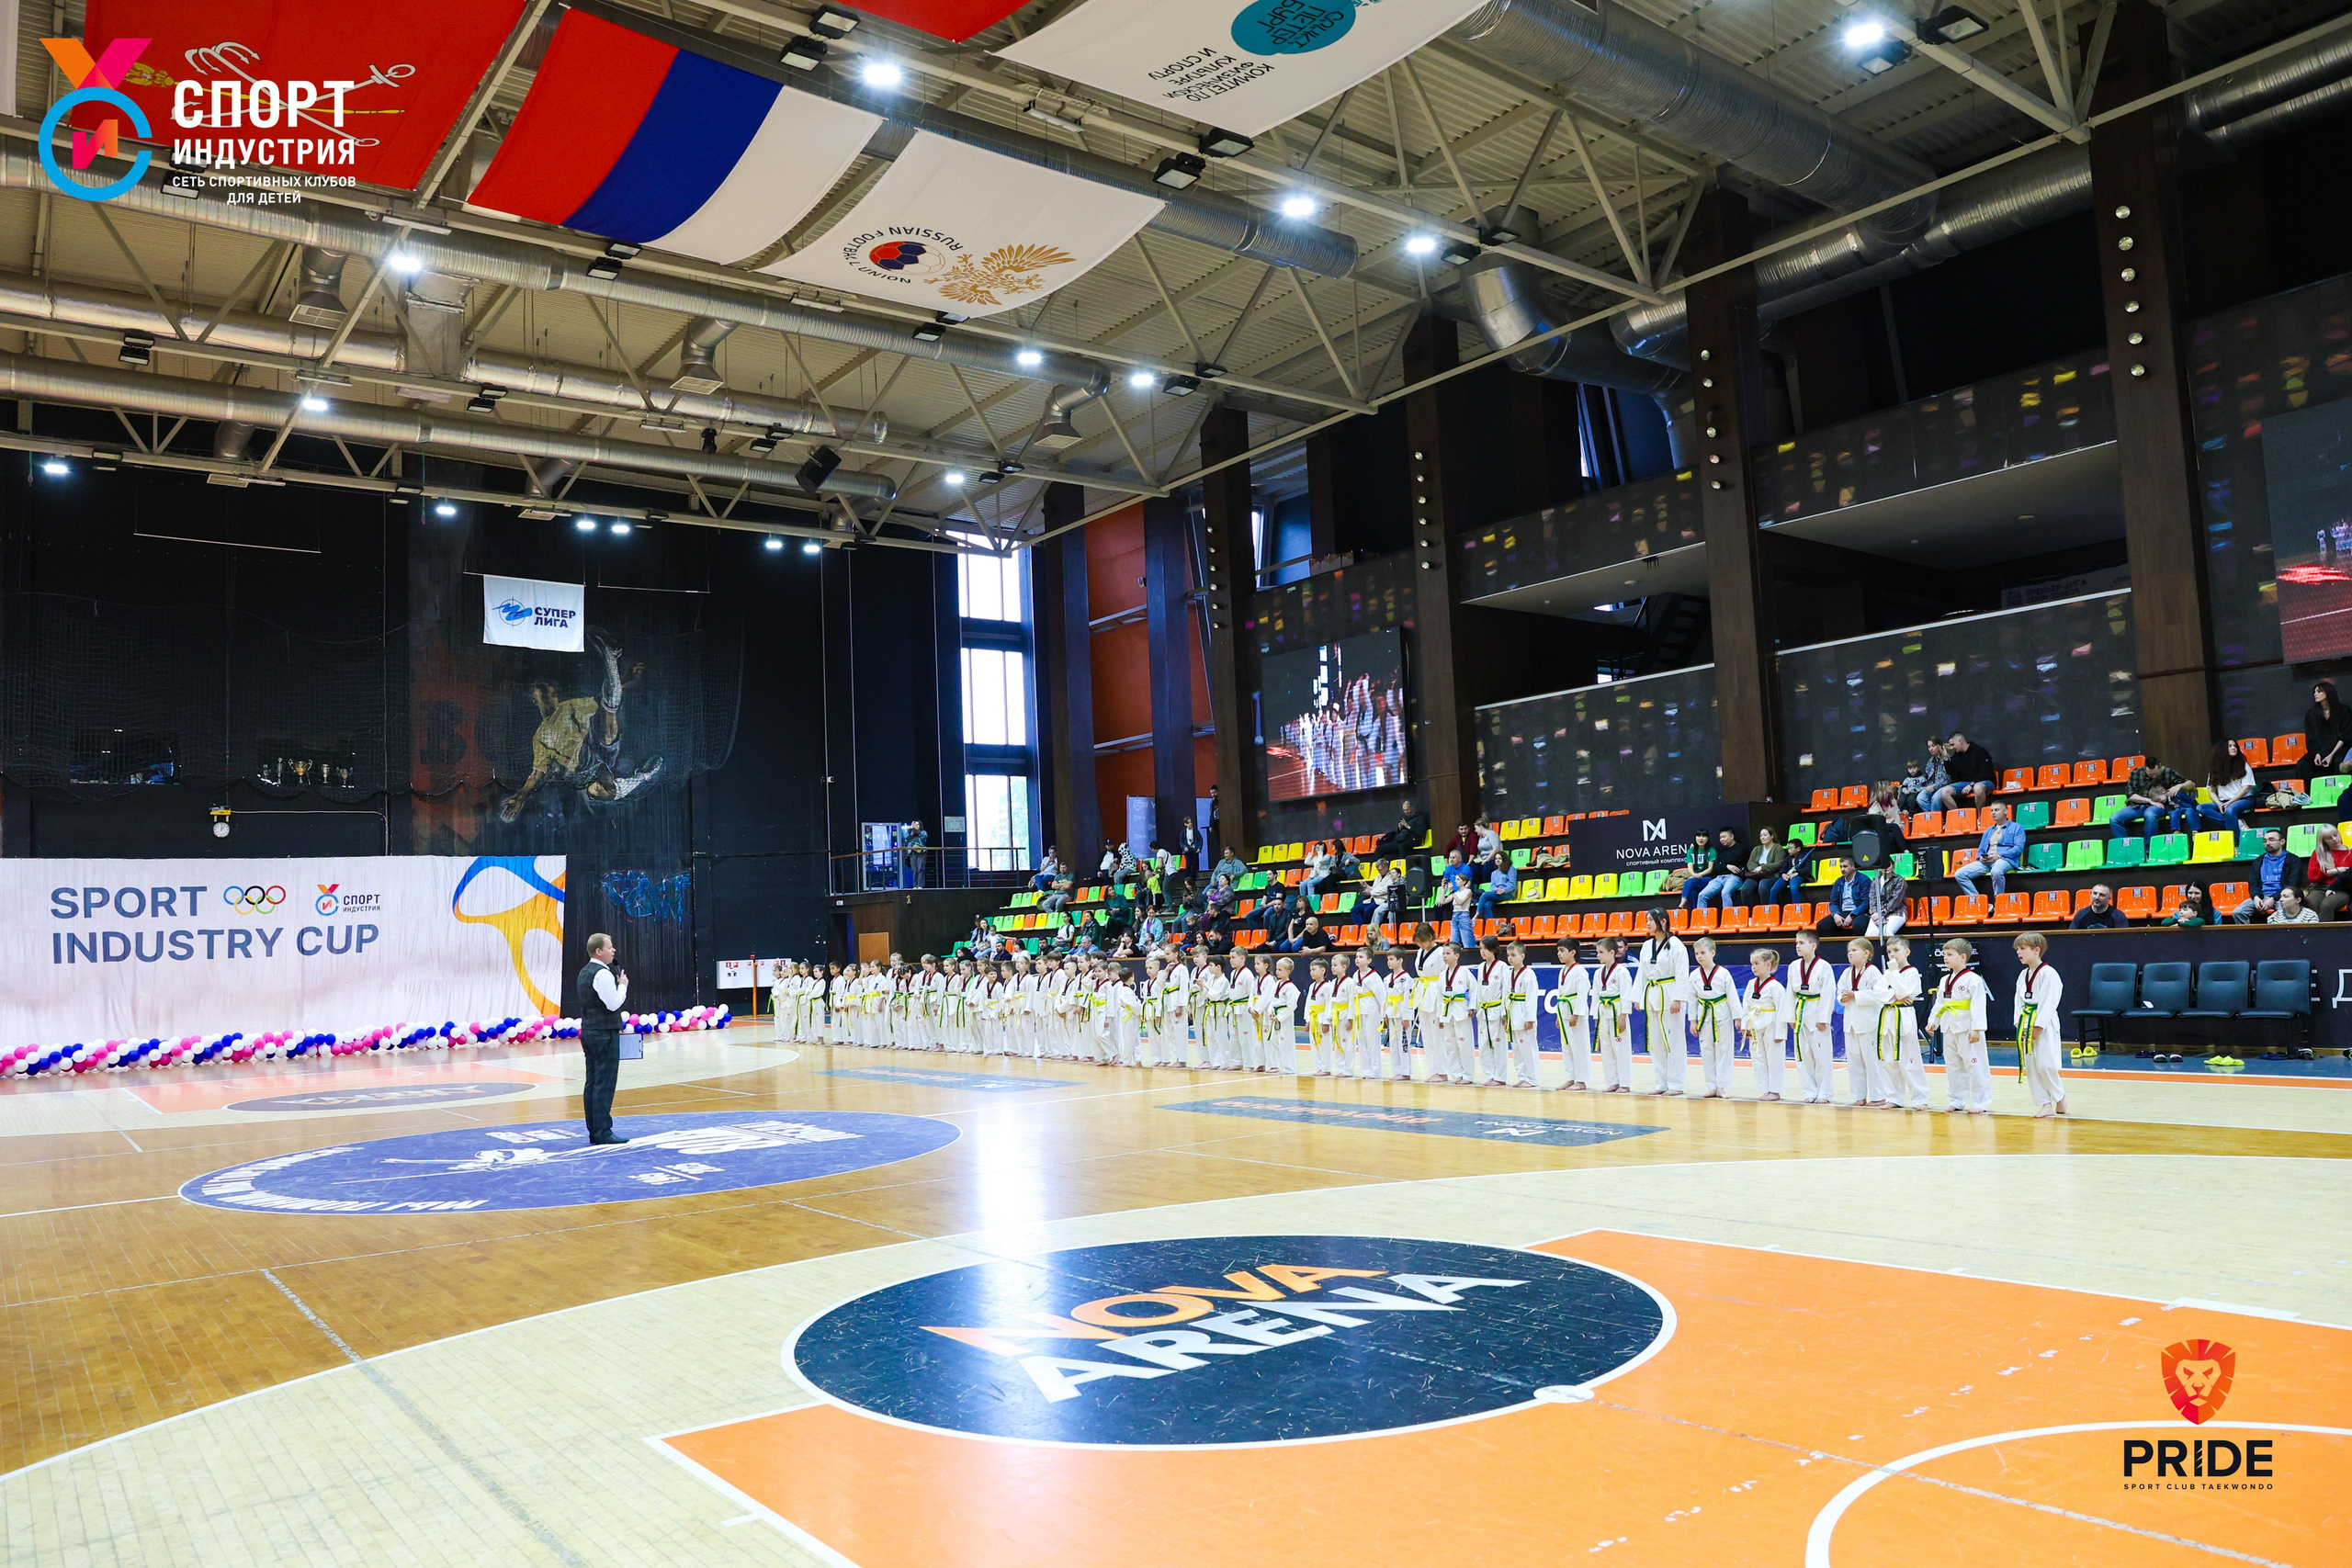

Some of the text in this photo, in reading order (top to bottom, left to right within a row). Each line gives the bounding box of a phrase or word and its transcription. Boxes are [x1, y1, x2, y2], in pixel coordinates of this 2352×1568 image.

[1271, 6, 1326, 45] ПЕТЕР
[1148, 47, 1217, 81] И СПОРТУ
[1162, 62, 1254, 99] ФИЗИЧЕСКОЙ
[1168, 55, 1237, 87] КУЛЬТУРЕ
[1186, 63, 1274, 103] КОМИТЕТ ПО
[842, 227, 964, 284] RUSSIAN FOOTBALL UNION
[534, 606, 576, 619] СУПЕР
[534, 617, 568, 628] ЛИГА
[1616, 847, 1651, 860] NOVA
[51, 885, 208, 919] SPORT
[343, 905, 380, 913] ИНДУСТРИЯ
[344, 895, 380, 906] СПОРТ
[52, 923, 379, 964] INDUSTRY CUP
[921, 1263, 1388, 1358] NOVA
[1017, 1271, 1531, 1404] ARENA
